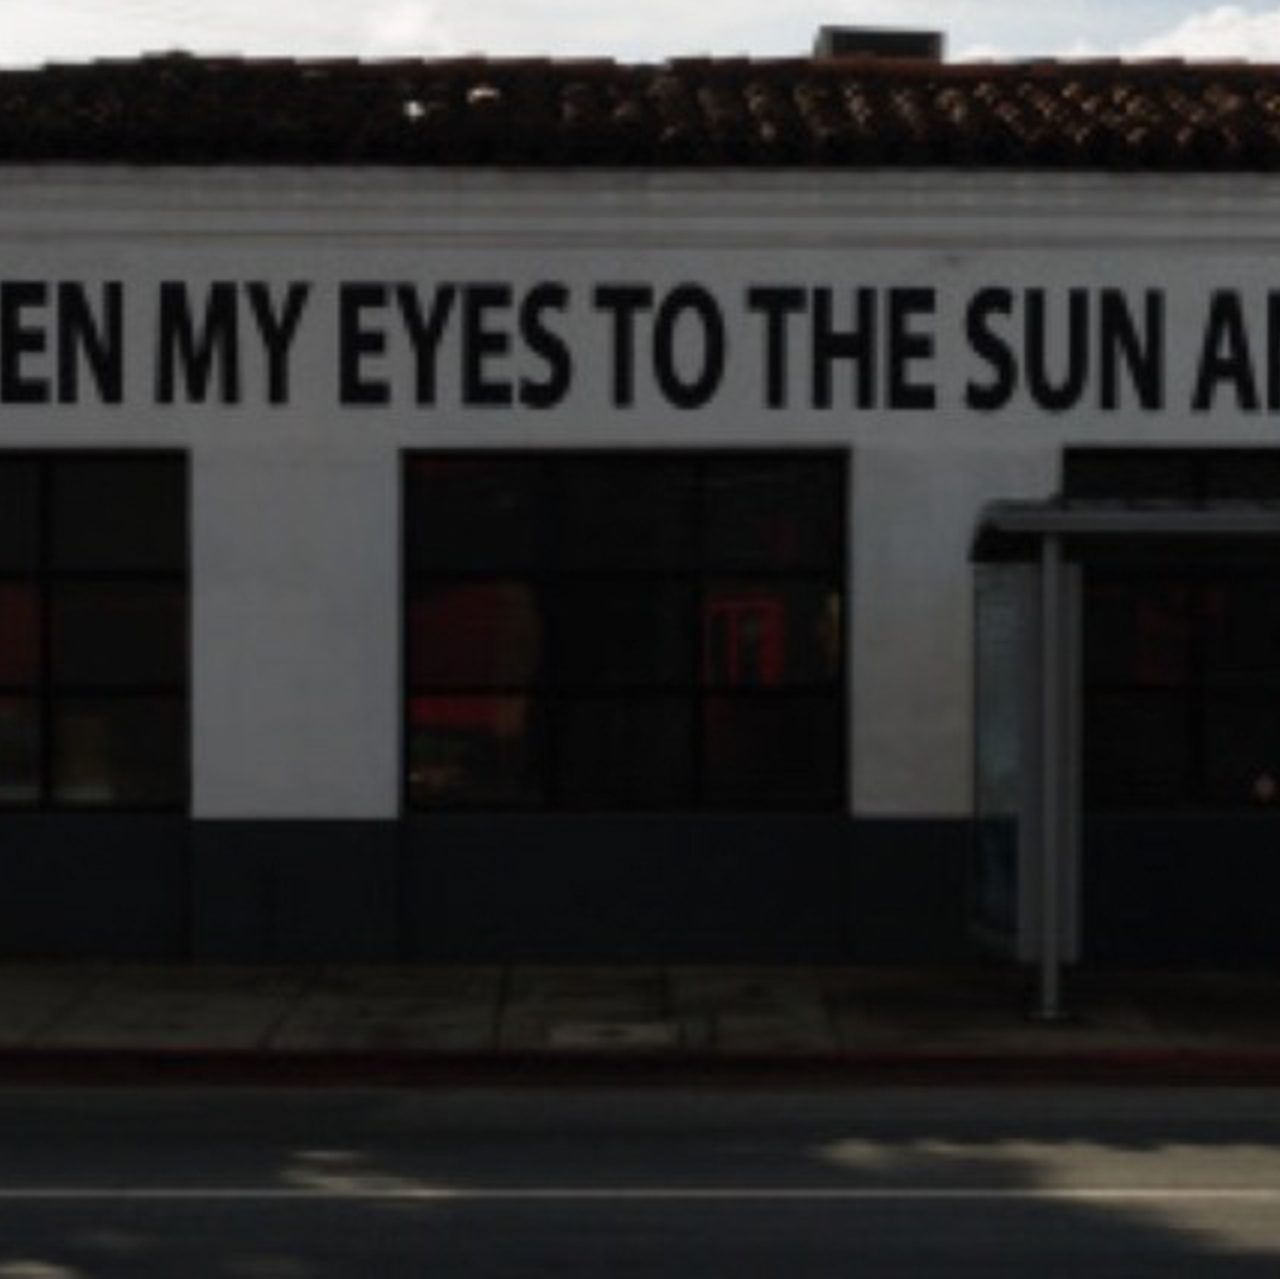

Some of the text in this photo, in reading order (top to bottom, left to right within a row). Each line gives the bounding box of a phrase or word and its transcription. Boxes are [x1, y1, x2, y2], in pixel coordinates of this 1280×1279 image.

[154, 280, 311, 406] MY
[338, 280, 573, 410] EYES
[592, 282, 727, 411] TO
[745, 285, 937, 411] THE
[964, 286, 1165, 414] SUN
